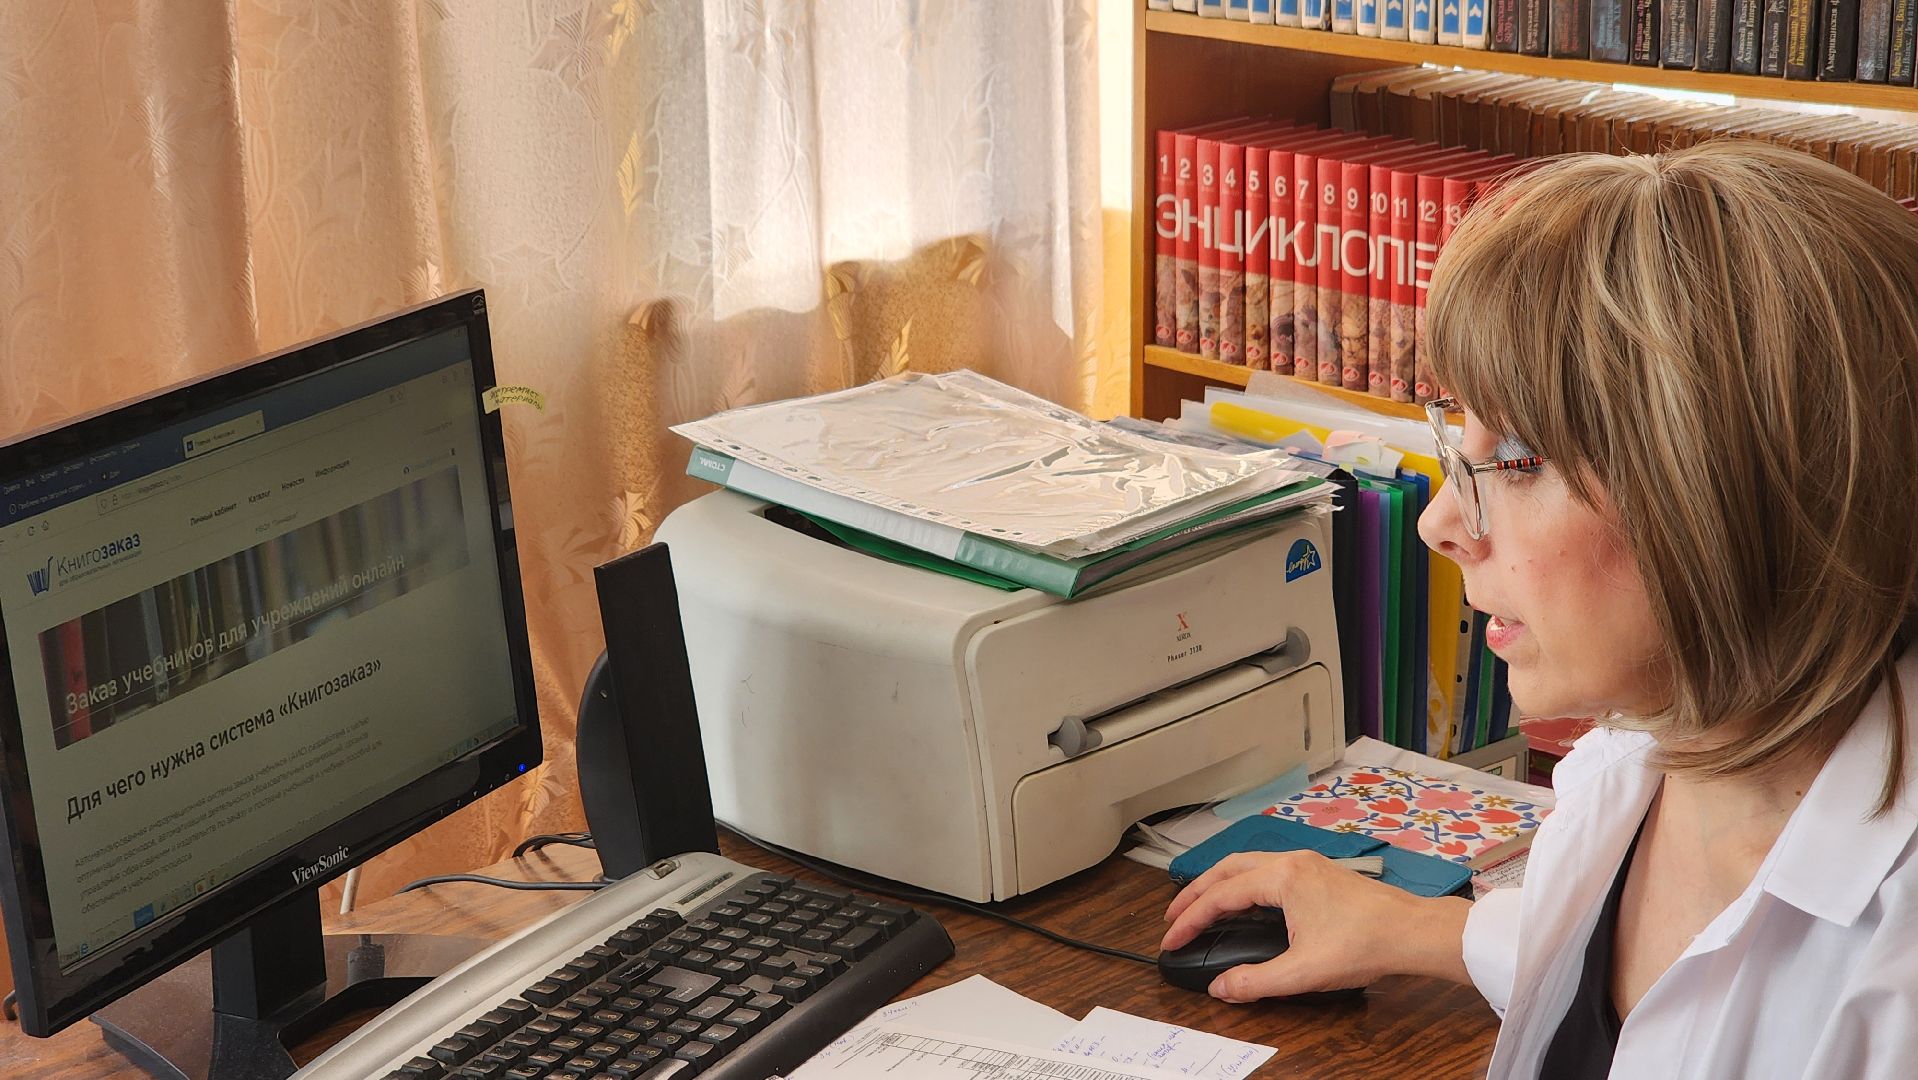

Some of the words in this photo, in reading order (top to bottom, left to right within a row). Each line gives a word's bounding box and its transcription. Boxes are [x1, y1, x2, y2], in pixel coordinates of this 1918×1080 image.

[1825, 8, 1838, 72] Американская
[1161, 154, 1168, 175] 1
[1180, 158, 1191, 178] 2
[1203, 164, 1213, 185] 3
[1225, 168, 1236, 188] 4
[1249, 170, 1260, 191] 5
[1275, 176, 1286, 196] 6
[1298, 179, 1309, 200] 7
[1324, 184, 1335, 205] 8
[1347, 188, 1358, 209] 9
[1371, 192, 1387, 214] 10
[1394, 196, 1407, 218] 11
[1419, 199, 1436, 222] 12
[1444, 204, 1462, 225] 13
[1156, 193, 1437, 289] ЭНЦИКЛОПЕ
[281, 477, 305, 491] Новости
[248, 490, 271, 504] Каталог
[56, 533, 141, 576] Книгозаказ
[65, 676, 119, 715] Заказ
[121, 638, 214, 693] учебников
[218, 623, 248, 652] для
[251, 580, 349, 637] учреждений
[352, 554, 405, 589] онлайн
[1167, 651, 1187, 663] Phaser
[67, 791, 102, 824] Для
[106, 770, 146, 798] чего
[150, 741, 206, 779] нужна
[209, 708, 275, 751] система
[278, 658, 382, 717] «Книгозаказ»
[291, 844, 350, 886] ViewSonic
